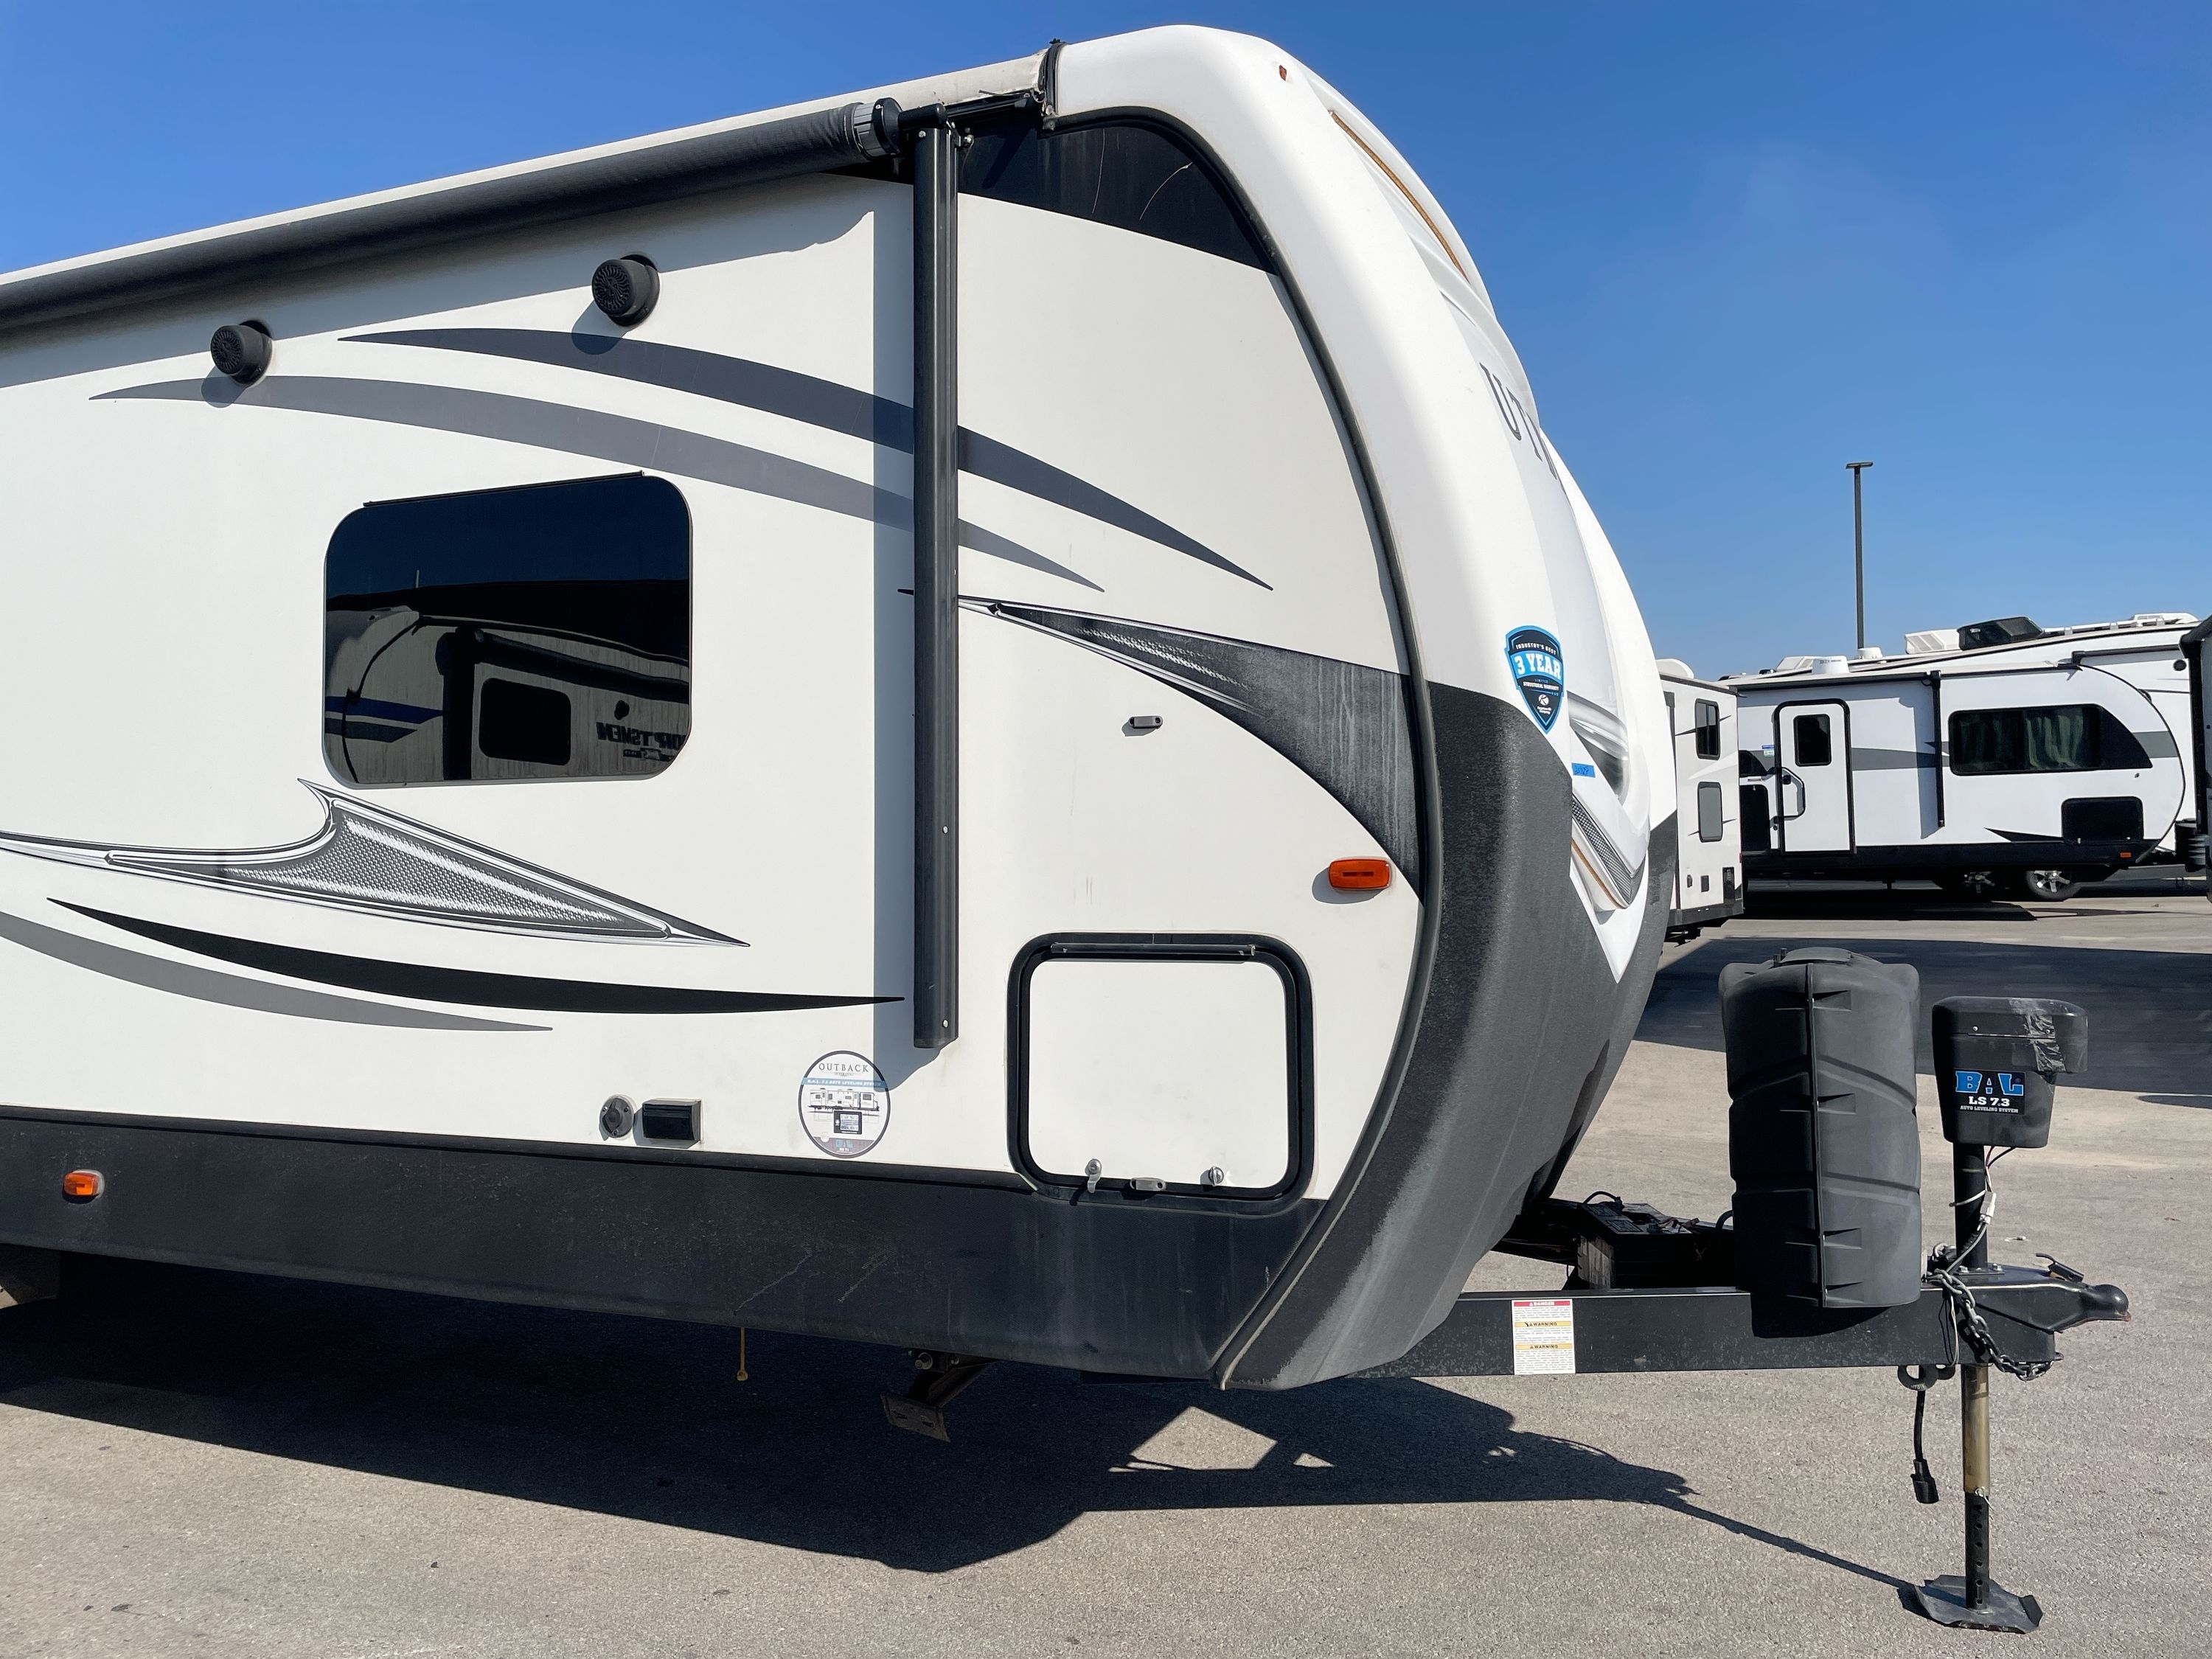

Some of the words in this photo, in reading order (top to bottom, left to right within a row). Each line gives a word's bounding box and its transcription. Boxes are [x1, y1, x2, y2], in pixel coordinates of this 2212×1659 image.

[1545, 646, 1557, 655] BEST
[1514, 655, 1526, 675] 3
[1526, 653, 1561, 681] YEAR
[818, 1062, 869, 1072] OUTBACK
[1969, 1096, 1987, 1105] LS
